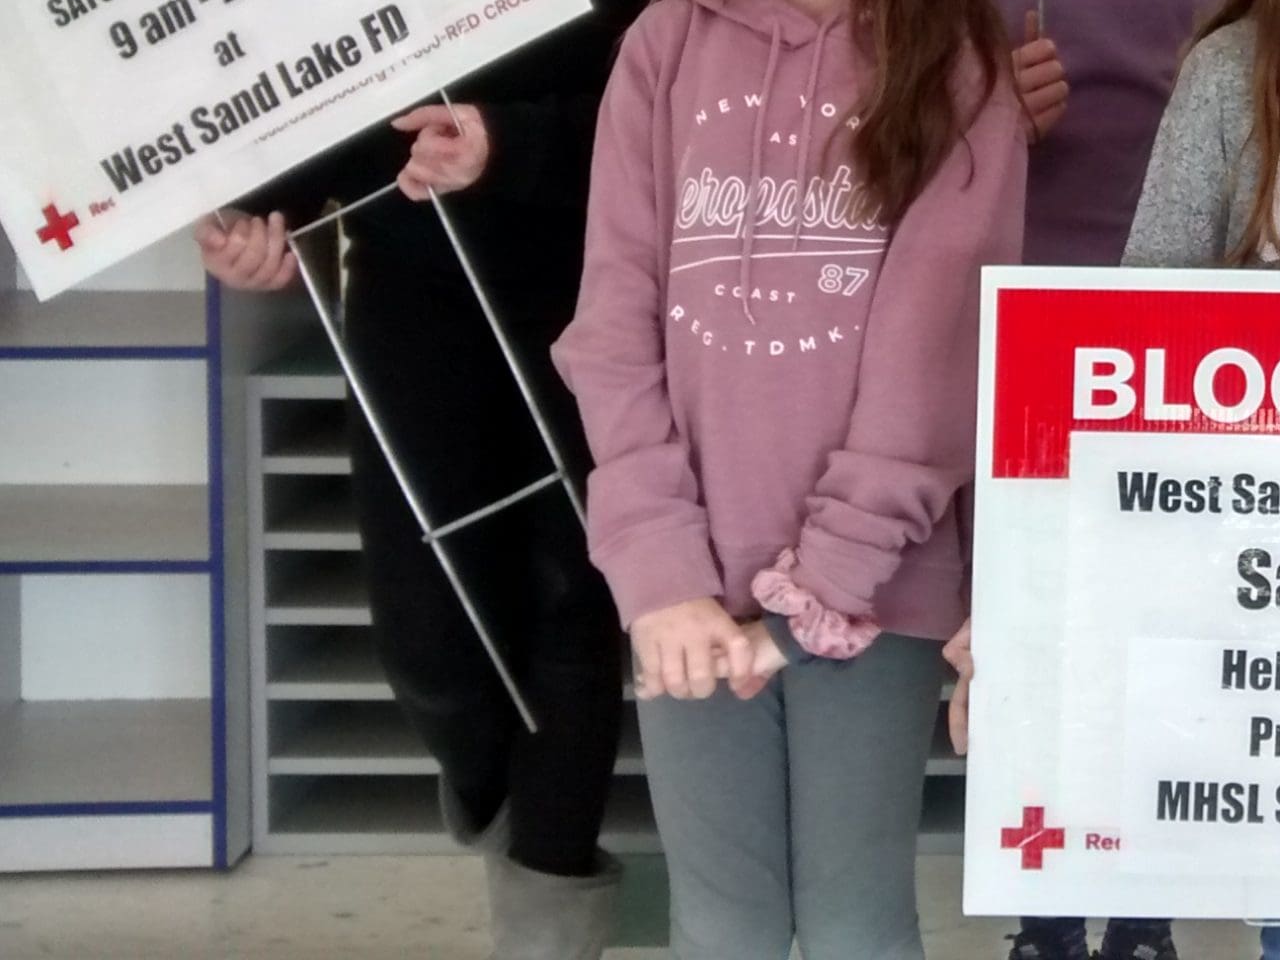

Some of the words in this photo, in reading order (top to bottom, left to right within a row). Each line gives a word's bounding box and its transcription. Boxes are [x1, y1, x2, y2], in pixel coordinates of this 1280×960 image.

[109, 21, 139, 60] 9
[213, 30, 246, 67] at
[100, 122, 197, 193] West
[190, 70, 281, 144] Sand
[276, 35, 362, 98] Lake
[360, 3, 410, 55] FD
[695, 94, 763, 125] NEW
[800, 94, 860, 131] YOR
[817, 263, 870, 297] 87
[1117, 471, 1222, 514] West
[1156, 780, 1264, 825] MHSL
